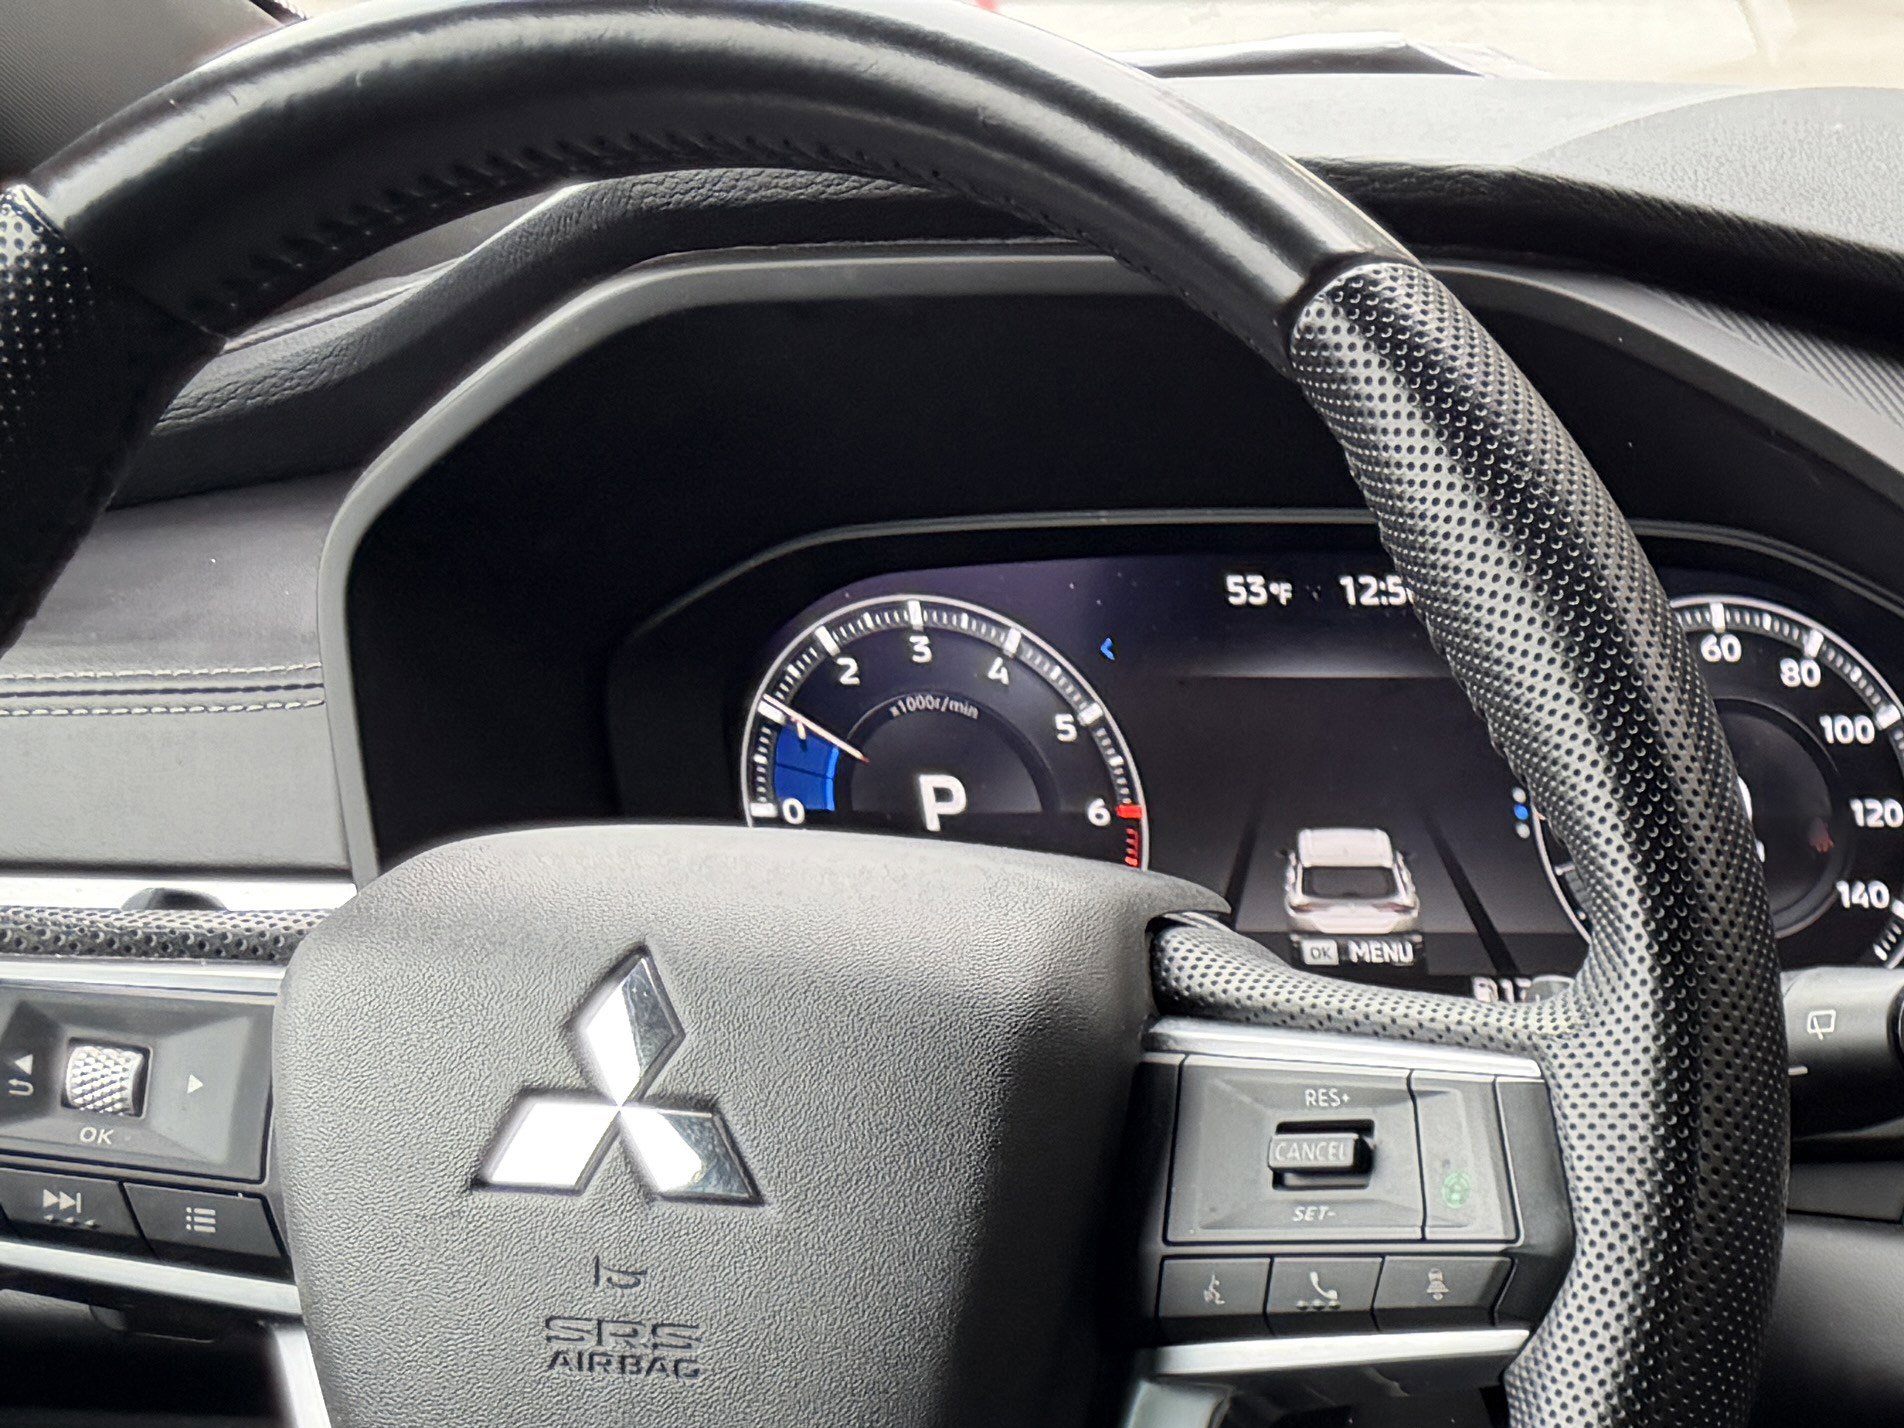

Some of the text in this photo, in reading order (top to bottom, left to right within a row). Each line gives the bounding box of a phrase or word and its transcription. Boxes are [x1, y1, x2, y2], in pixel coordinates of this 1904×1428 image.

[1339, 575, 1414, 606] 12:5
[910, 636, 932, 664] 3
[1700, 634, 1742, 663] 60
[836, 658, 861, 686] 2
[988, 658, 1010, 687] 4
[1780, 658, 1821, 688] 80
[1054, 715, 1077, 743] 5
[1819, 715, 1876, 745] 100
[782, 798, 805, 825] 0
[918, 774, 967, 832] P
[1086, 799, 1111, 827] 6
[1850, 800, 1904, 828] 120
[1836, 880, 1890, 909] 140
[1310, 942, 1415, 963] OK MENU
[1305, 1089, 1350, 1106] RES+
[79, 1126, 113, 1145] OK
[1275, 1142, 1346, 1161] CANCEL
[545, 1315, 702, 1352] SRS
[547, 1351, 702, 1379] AIRBAG
